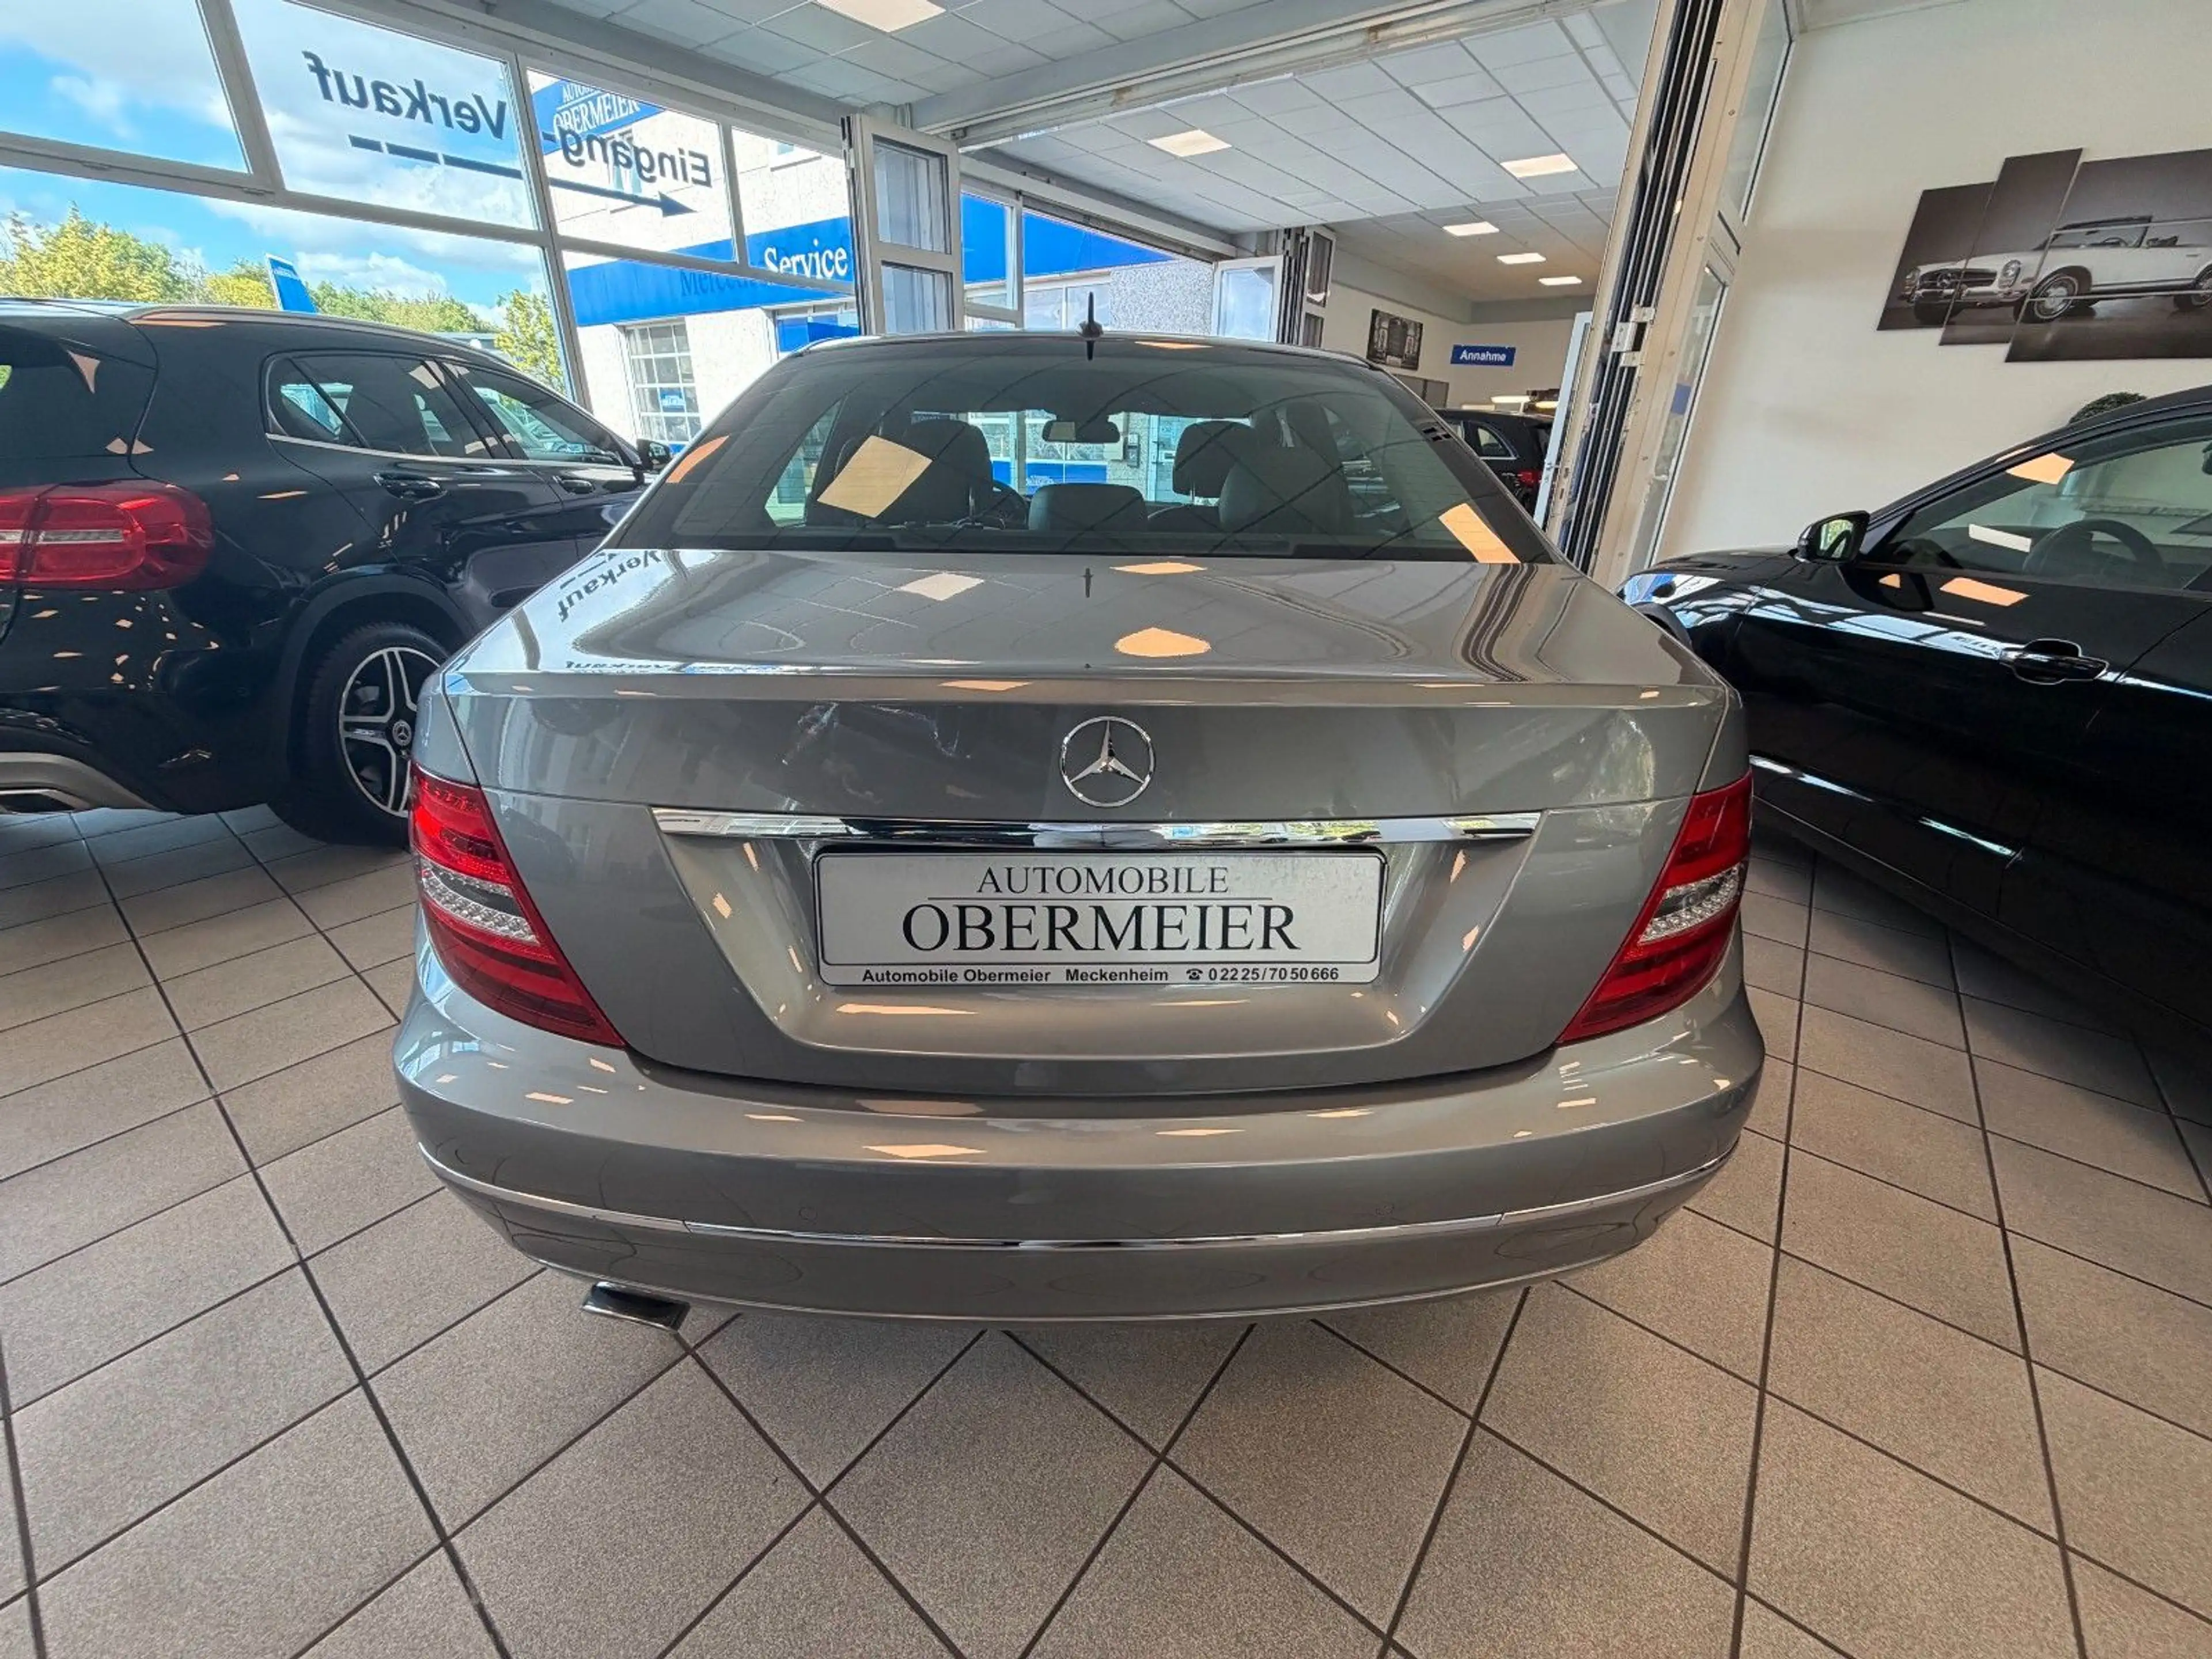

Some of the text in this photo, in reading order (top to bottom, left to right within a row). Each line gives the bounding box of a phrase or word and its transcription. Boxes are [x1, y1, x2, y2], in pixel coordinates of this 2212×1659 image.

[764, 238, 848, 279] Service
[1460, 350, 1506, 361] Annahme
[976, 866, 1229, 894] AUTOMOBILE
[903, 904, 1301, 952] OBERMEIER
[862, 968, 959, 983] Automobile
[963, 968, 1051, 983] Obermeier
[1065, 968, 1168, 982] Meckenheim
